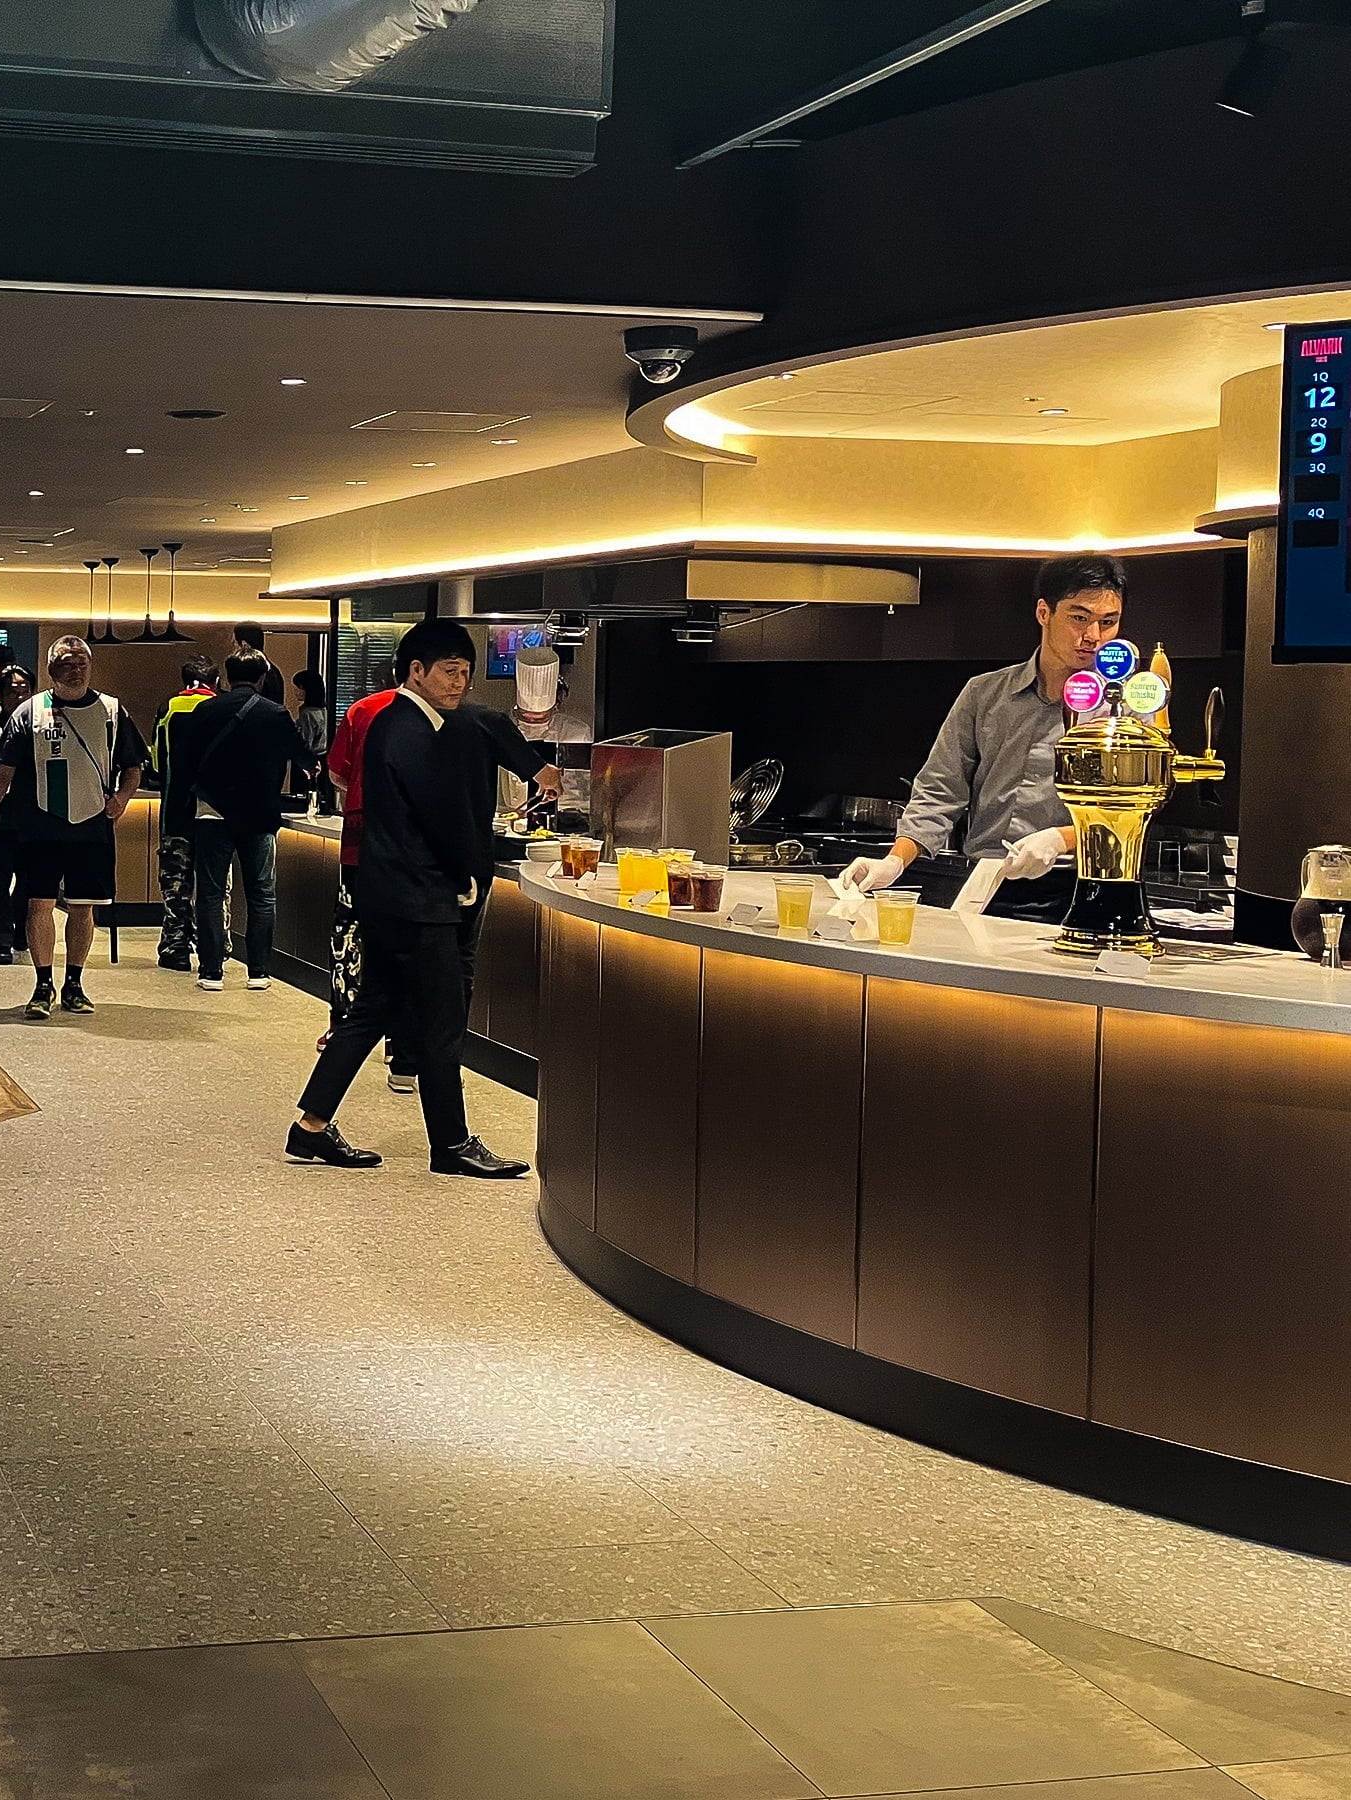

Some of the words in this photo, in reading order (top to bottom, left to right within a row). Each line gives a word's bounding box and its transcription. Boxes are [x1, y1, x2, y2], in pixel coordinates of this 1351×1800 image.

[1312, 372, 1329, 383] 1Q
[1304, 387, 1336, 409] 12
[1310, 417, 1327, 428] 2Q
[1310, 432, 1327, 453] 9
[1309, 463, 1326, 474] 3Q
[1307, 507, 1325, 519] 4Q
[45, 729, 67, 740] 004
